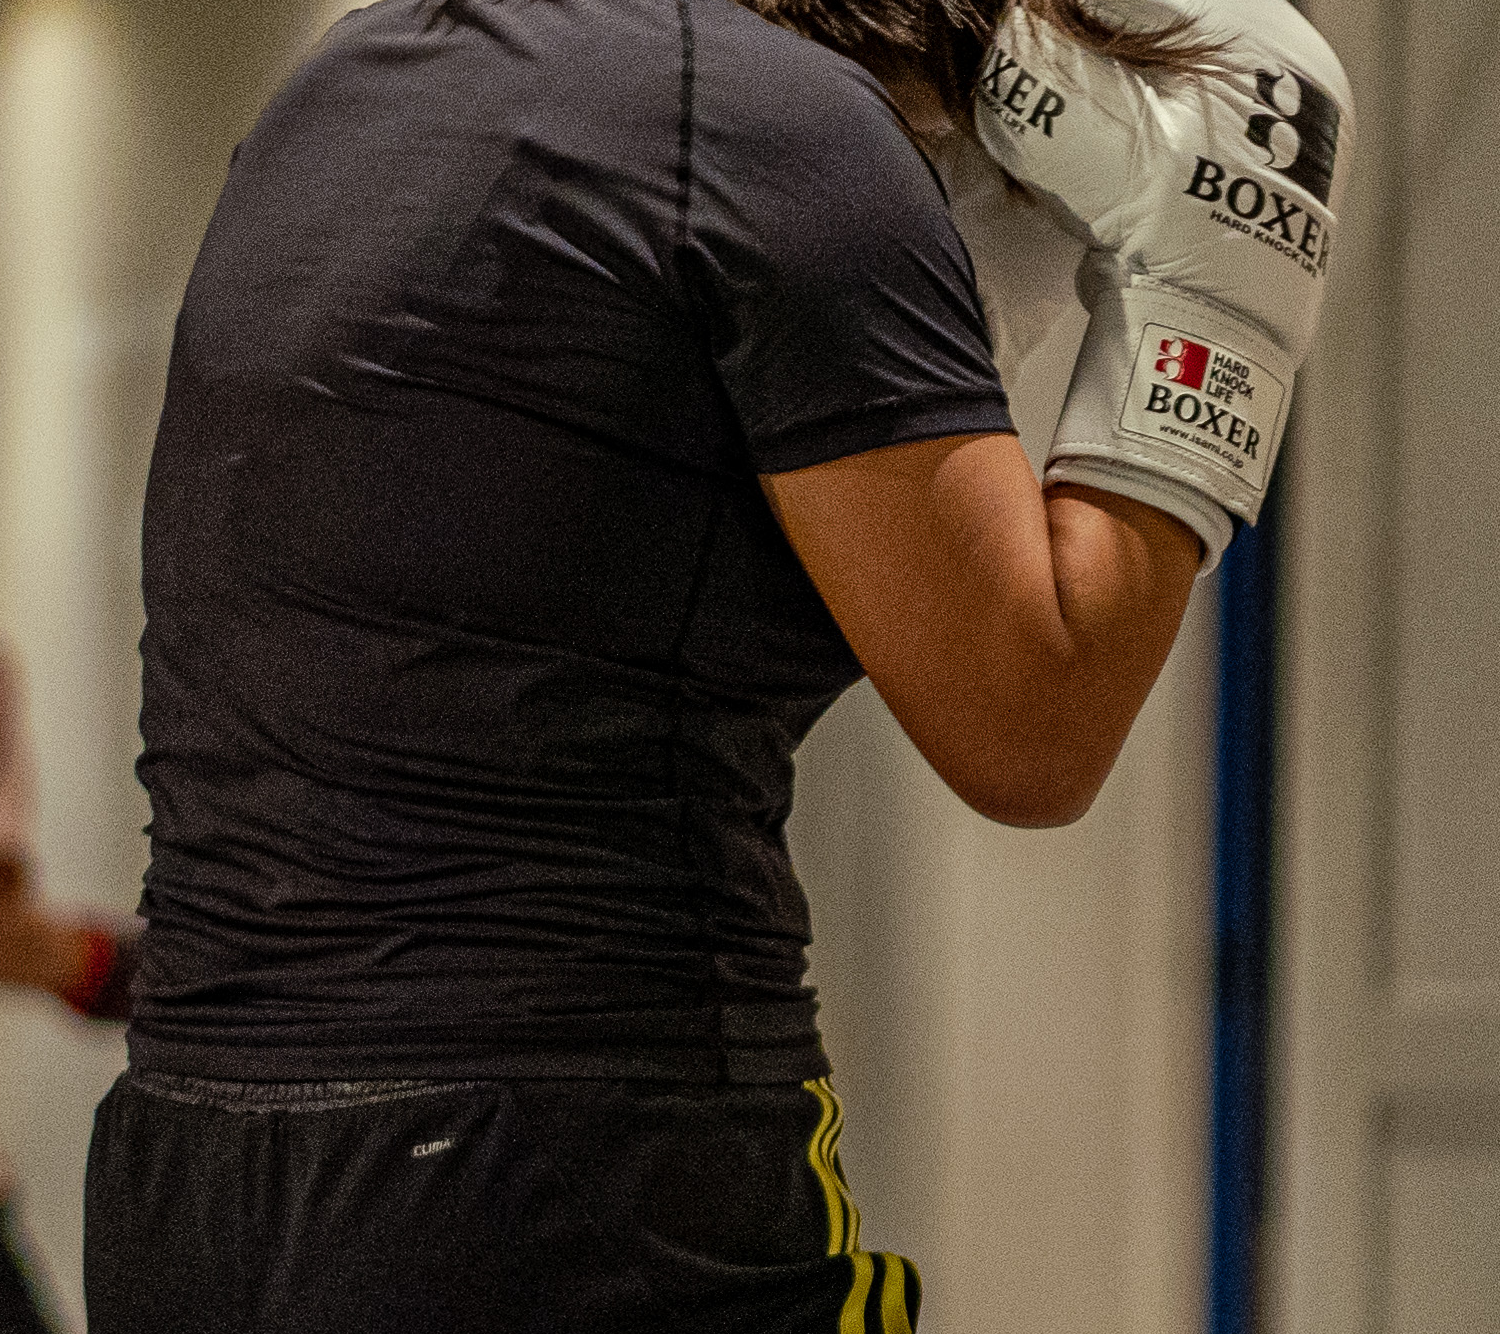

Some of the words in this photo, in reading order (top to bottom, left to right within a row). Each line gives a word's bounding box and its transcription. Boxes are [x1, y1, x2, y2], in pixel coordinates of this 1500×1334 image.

[980, 48, 1066, 138] XER
[1209, 209, 1251, 234] HARD
[1253, 229, 1301, 262] KNOCK
[1210, 368, 1255, 400] KNOCK
[1213, 352, 1250, 379] HARD
[1206, 381, 1234, 405] LIFE
[1144, 383, 1260, 460] BOXER
[1159, 424, 1244, 469] www.isami.co.jp
